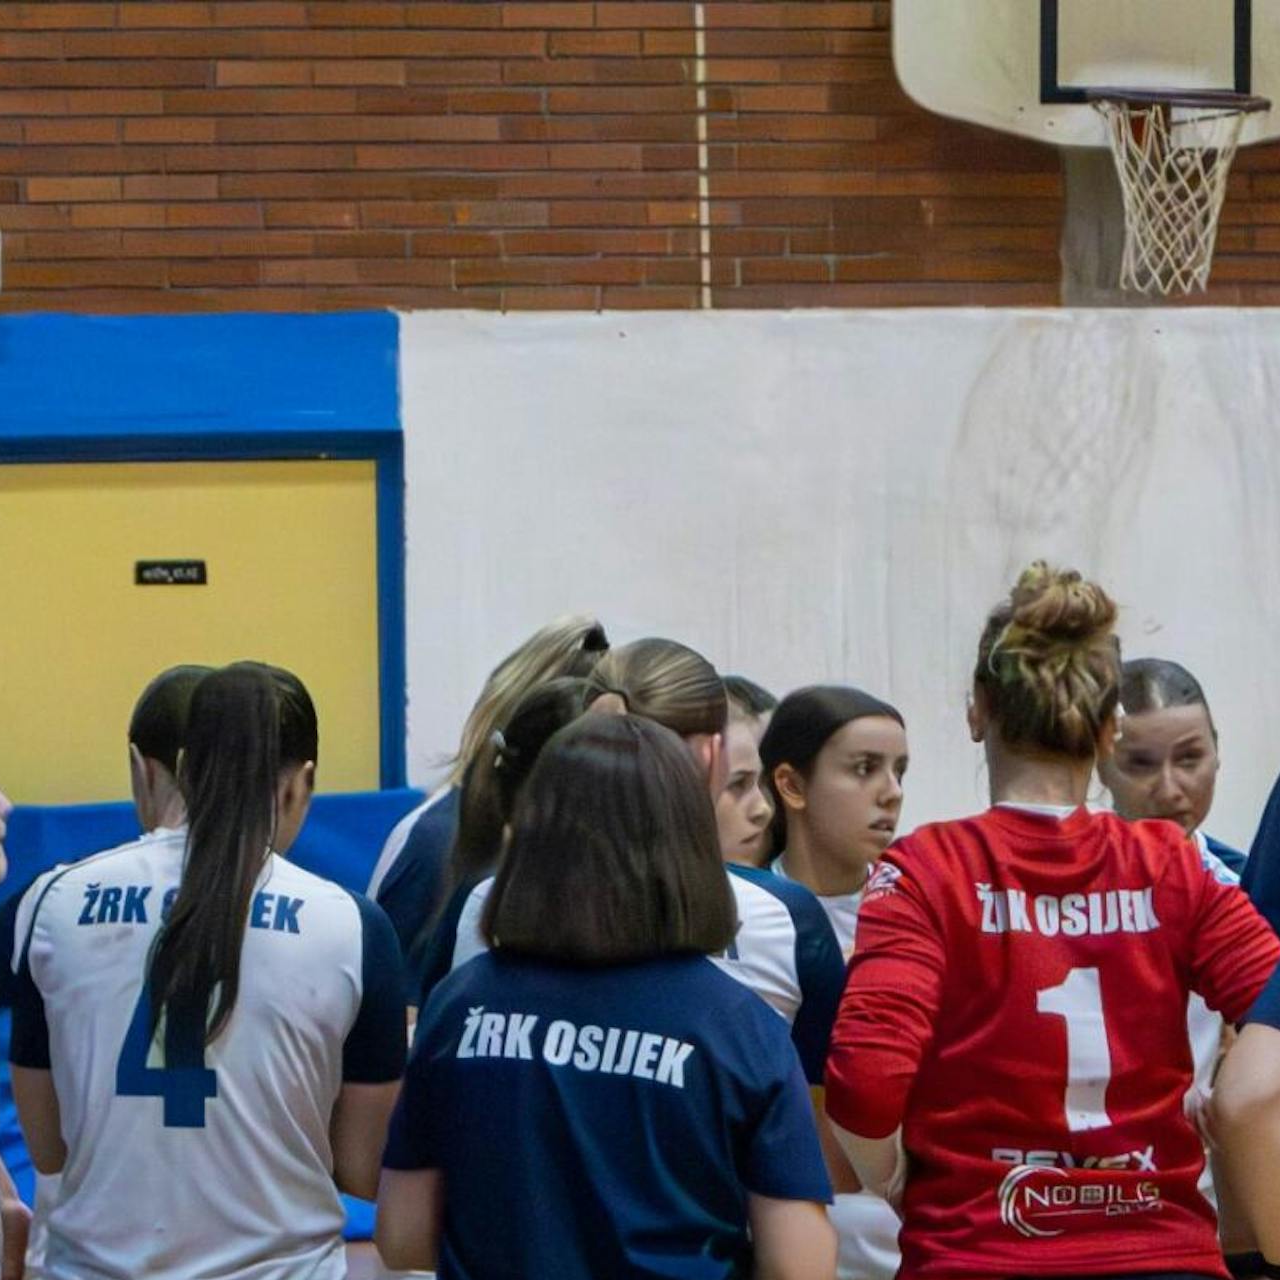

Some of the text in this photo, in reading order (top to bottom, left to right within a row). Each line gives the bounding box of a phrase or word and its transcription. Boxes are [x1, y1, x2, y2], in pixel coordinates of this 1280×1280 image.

[77, 882, 152, 926] ŽRK
[1034, 881, 1161, 937] OSIJEK
[115, 972, 218, 1128] 4
[456, 1005, 695, 1089] ŽRK OSIJEK
[1036, 967, 1113, 1132] 1
